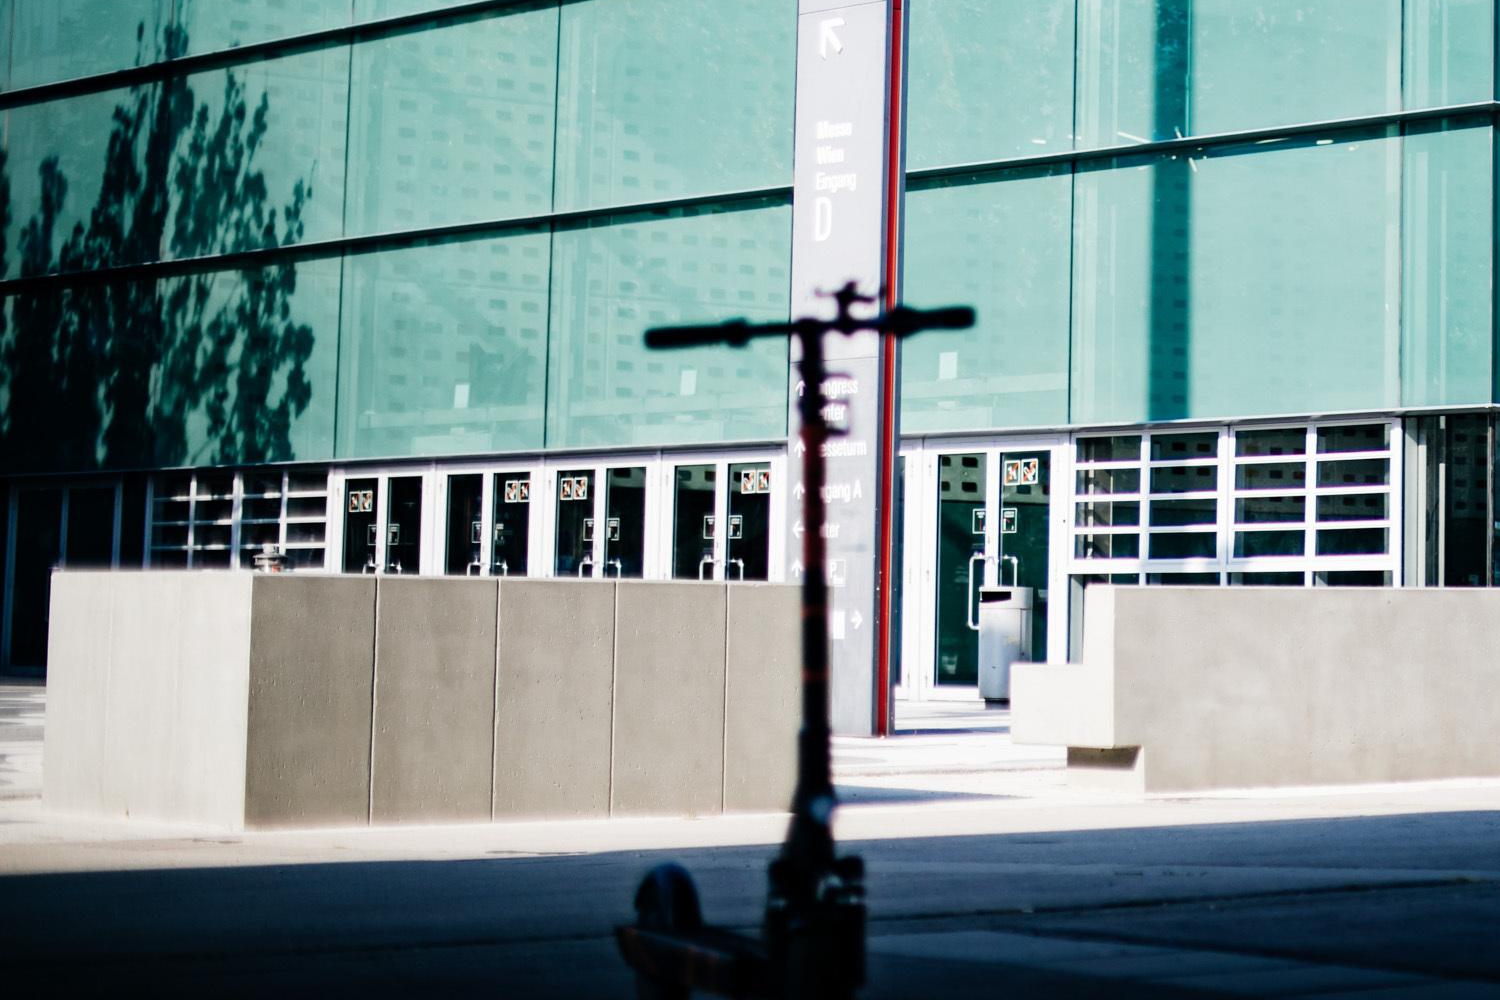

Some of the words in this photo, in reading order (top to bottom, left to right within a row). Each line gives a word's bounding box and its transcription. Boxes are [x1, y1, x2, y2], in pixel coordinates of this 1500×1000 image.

[815, 171, 857, 194] Eingang
[815, 196, 832, 242] D
[852, 479, 863, 499] A
